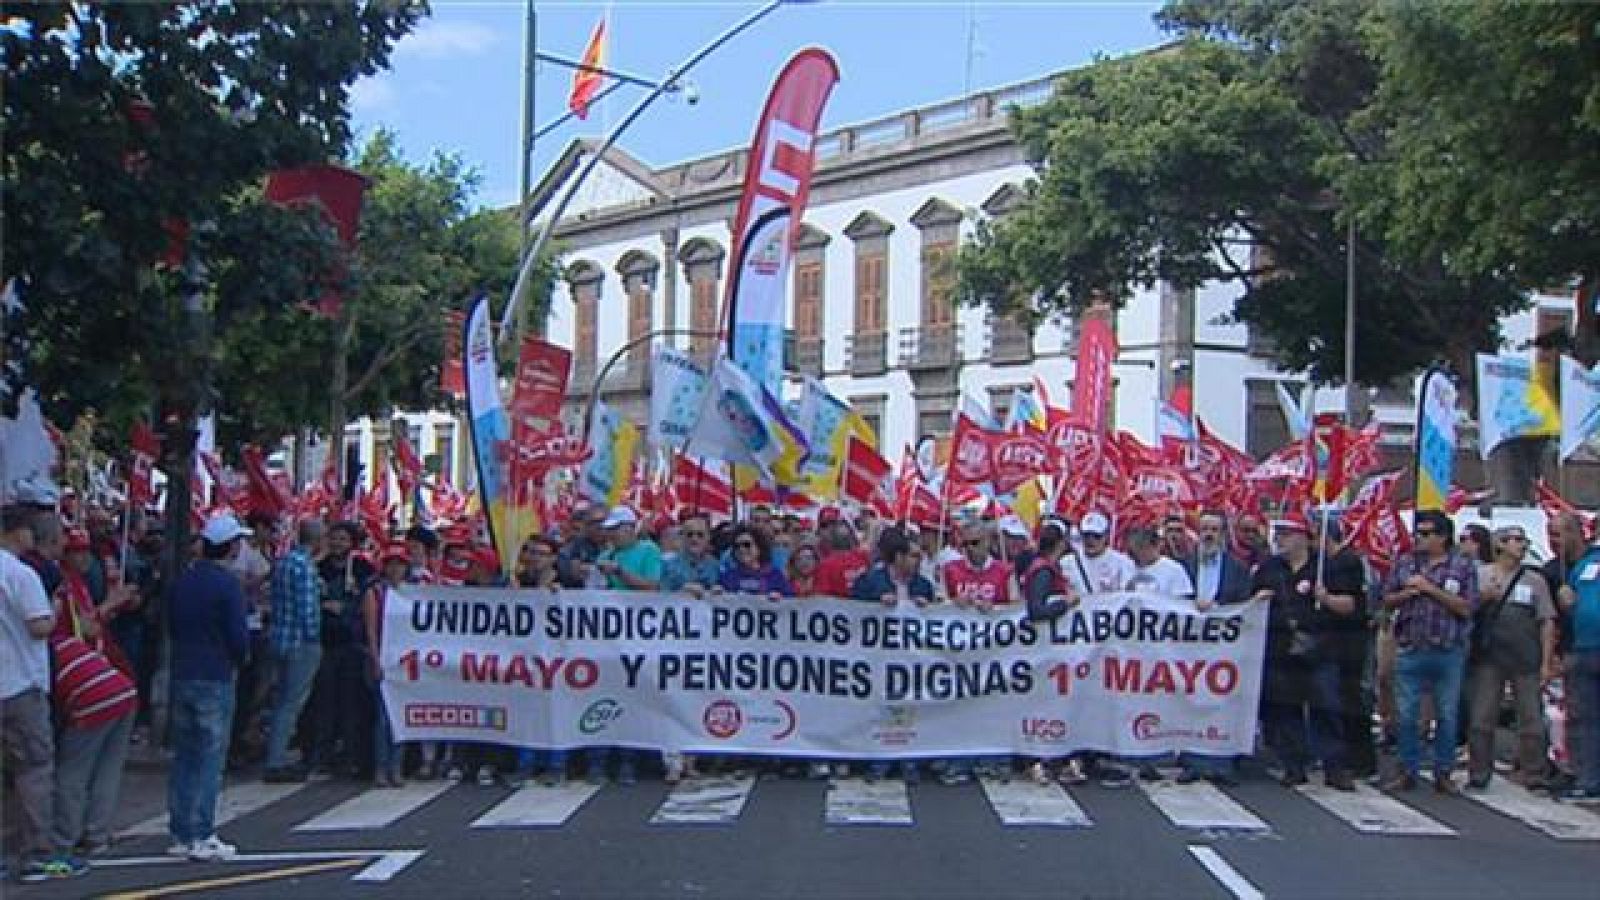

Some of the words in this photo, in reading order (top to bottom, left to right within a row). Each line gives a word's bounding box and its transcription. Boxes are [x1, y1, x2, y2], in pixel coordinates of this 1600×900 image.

[412, 600, 534, 637] UNIDAD
[545, 606, 701, 640] SINDICAL
[712, 607, 778, 639] POR
[790, 609, 849, 646] LOS
[861, 616, 1037, 651] DERECHOS
[1051, 608, 1243, 644] LABORALES
[461, 652, 599, 689] MAYO
[619, 654, 645, 688] Y
[659, 653, 871, 698] PENSIONES
[886, 660, 1033, 700] DIGNAS
[1104, 656, 1239, 695] MAYO
